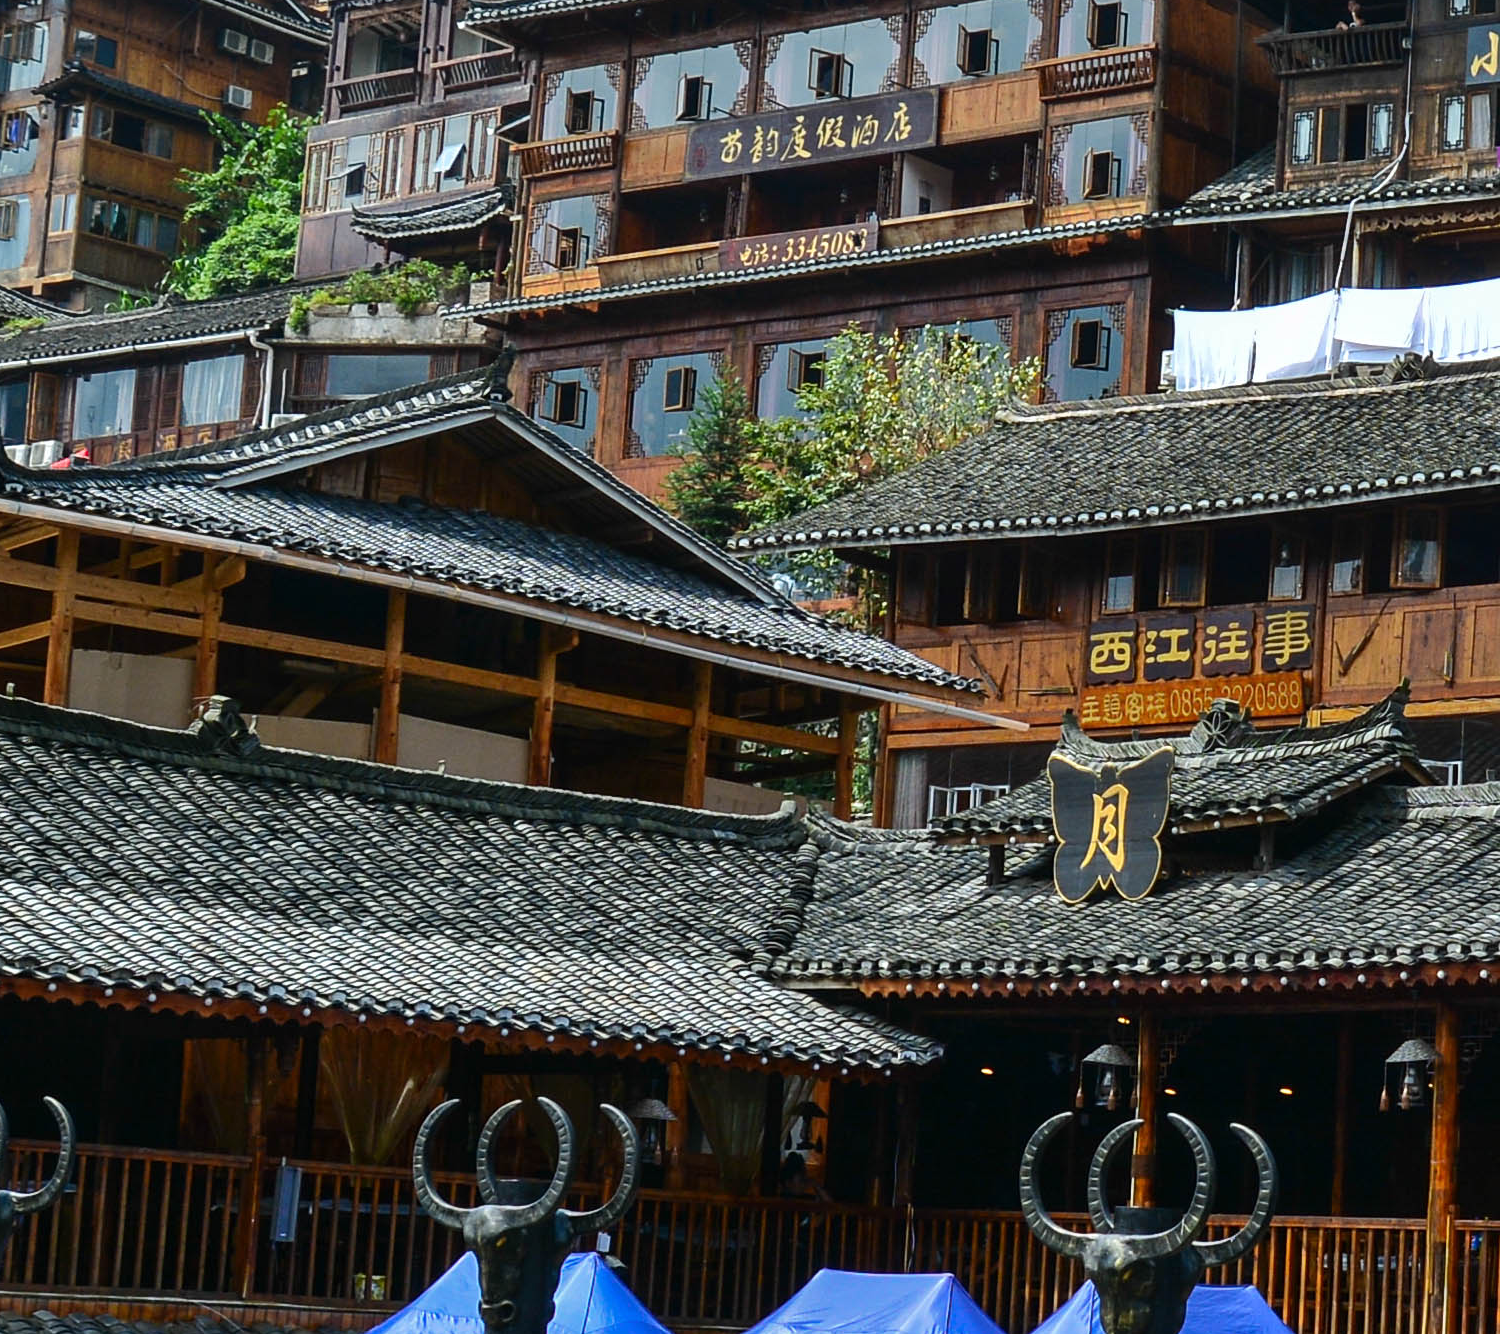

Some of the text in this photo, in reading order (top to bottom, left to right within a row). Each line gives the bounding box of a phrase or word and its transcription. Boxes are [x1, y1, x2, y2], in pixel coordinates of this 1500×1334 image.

[719, 102, 912, 164] 苗韵度假酒店
[1089, 610, 1310, 674] 西江往事
[1080, 783, 1129, 873] 月
